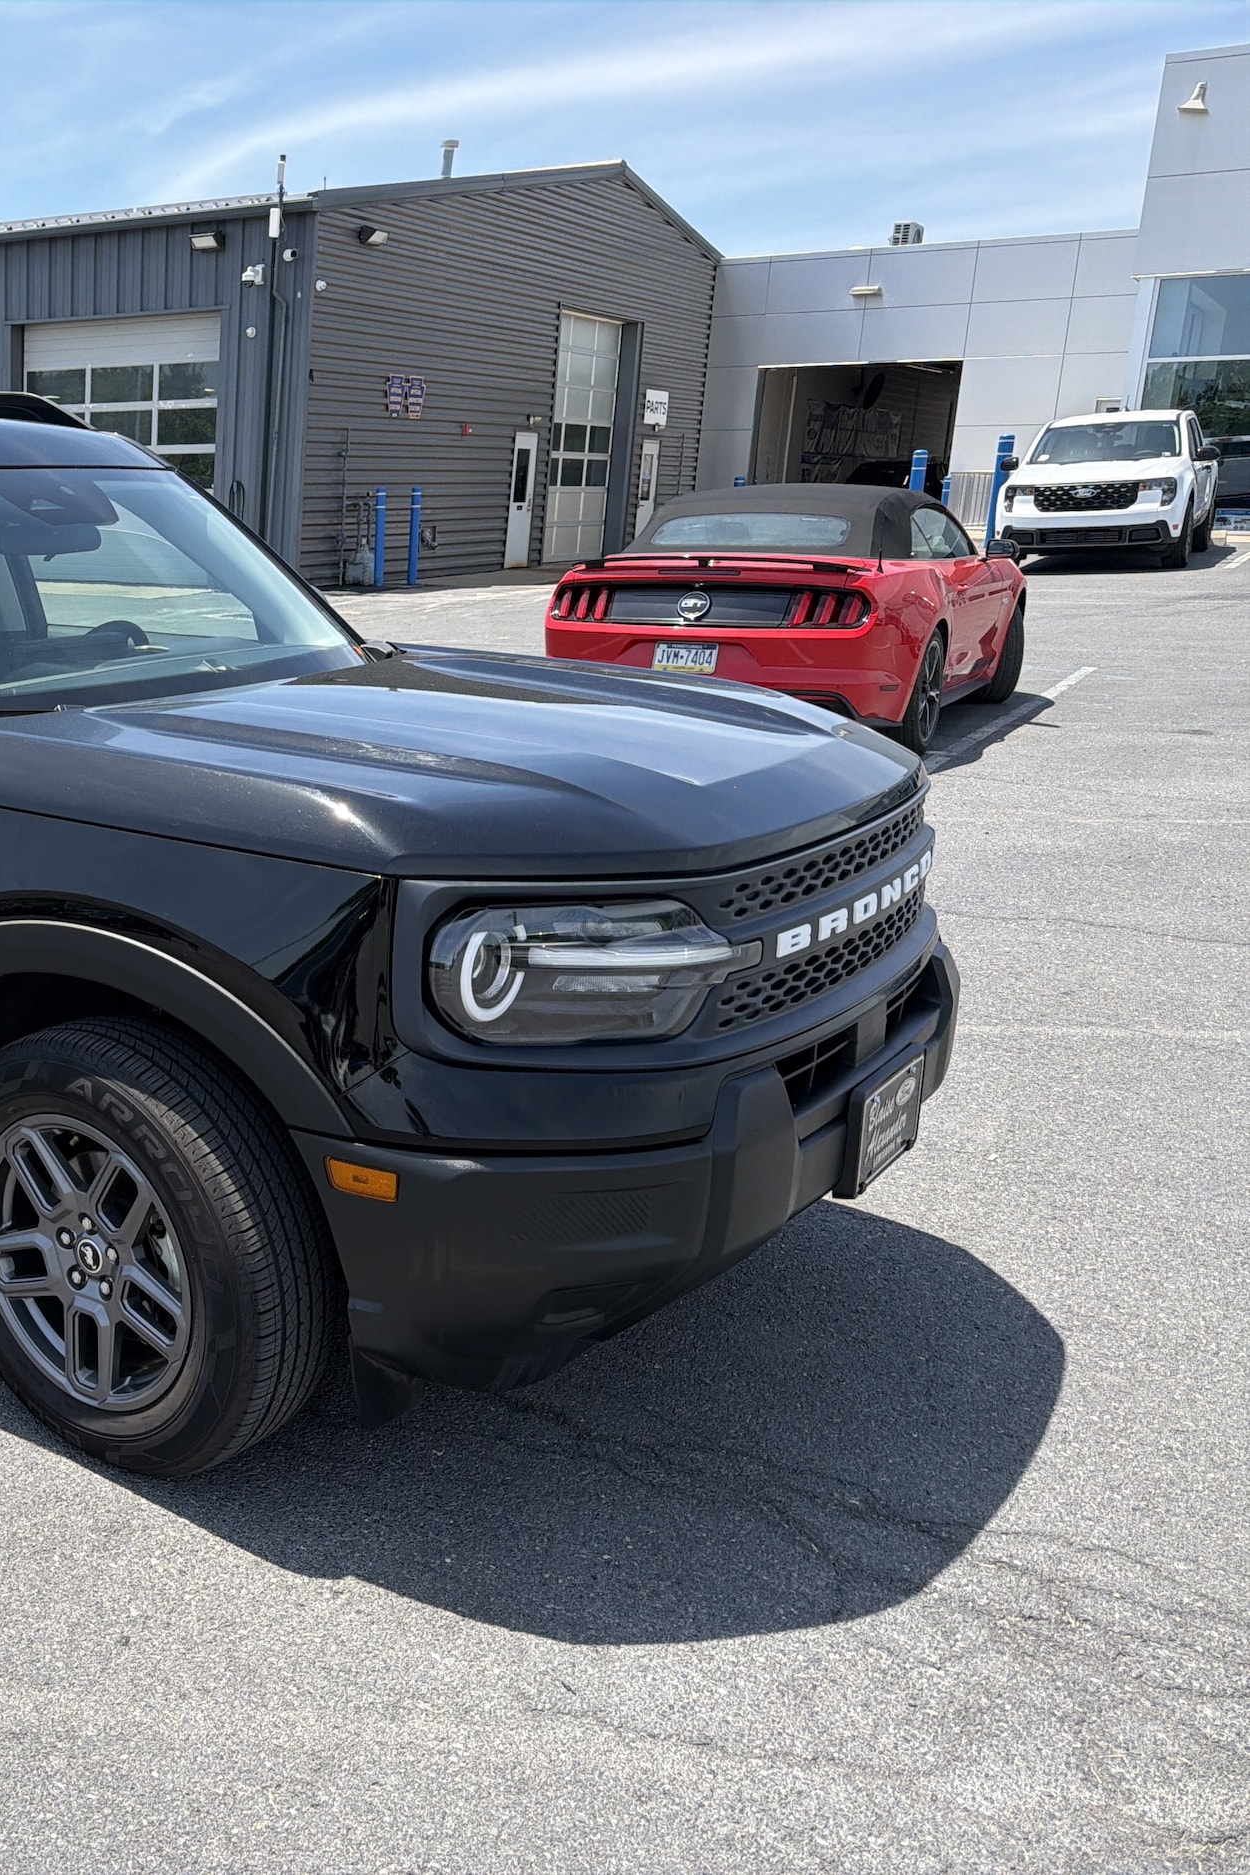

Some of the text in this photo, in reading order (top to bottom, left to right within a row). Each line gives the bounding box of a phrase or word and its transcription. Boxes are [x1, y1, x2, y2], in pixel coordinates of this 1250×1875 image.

[646, 400, 667, 415] PARTS
[681, 599, 707, 608] GT
[776, 851, 932, 958] BRONCO
